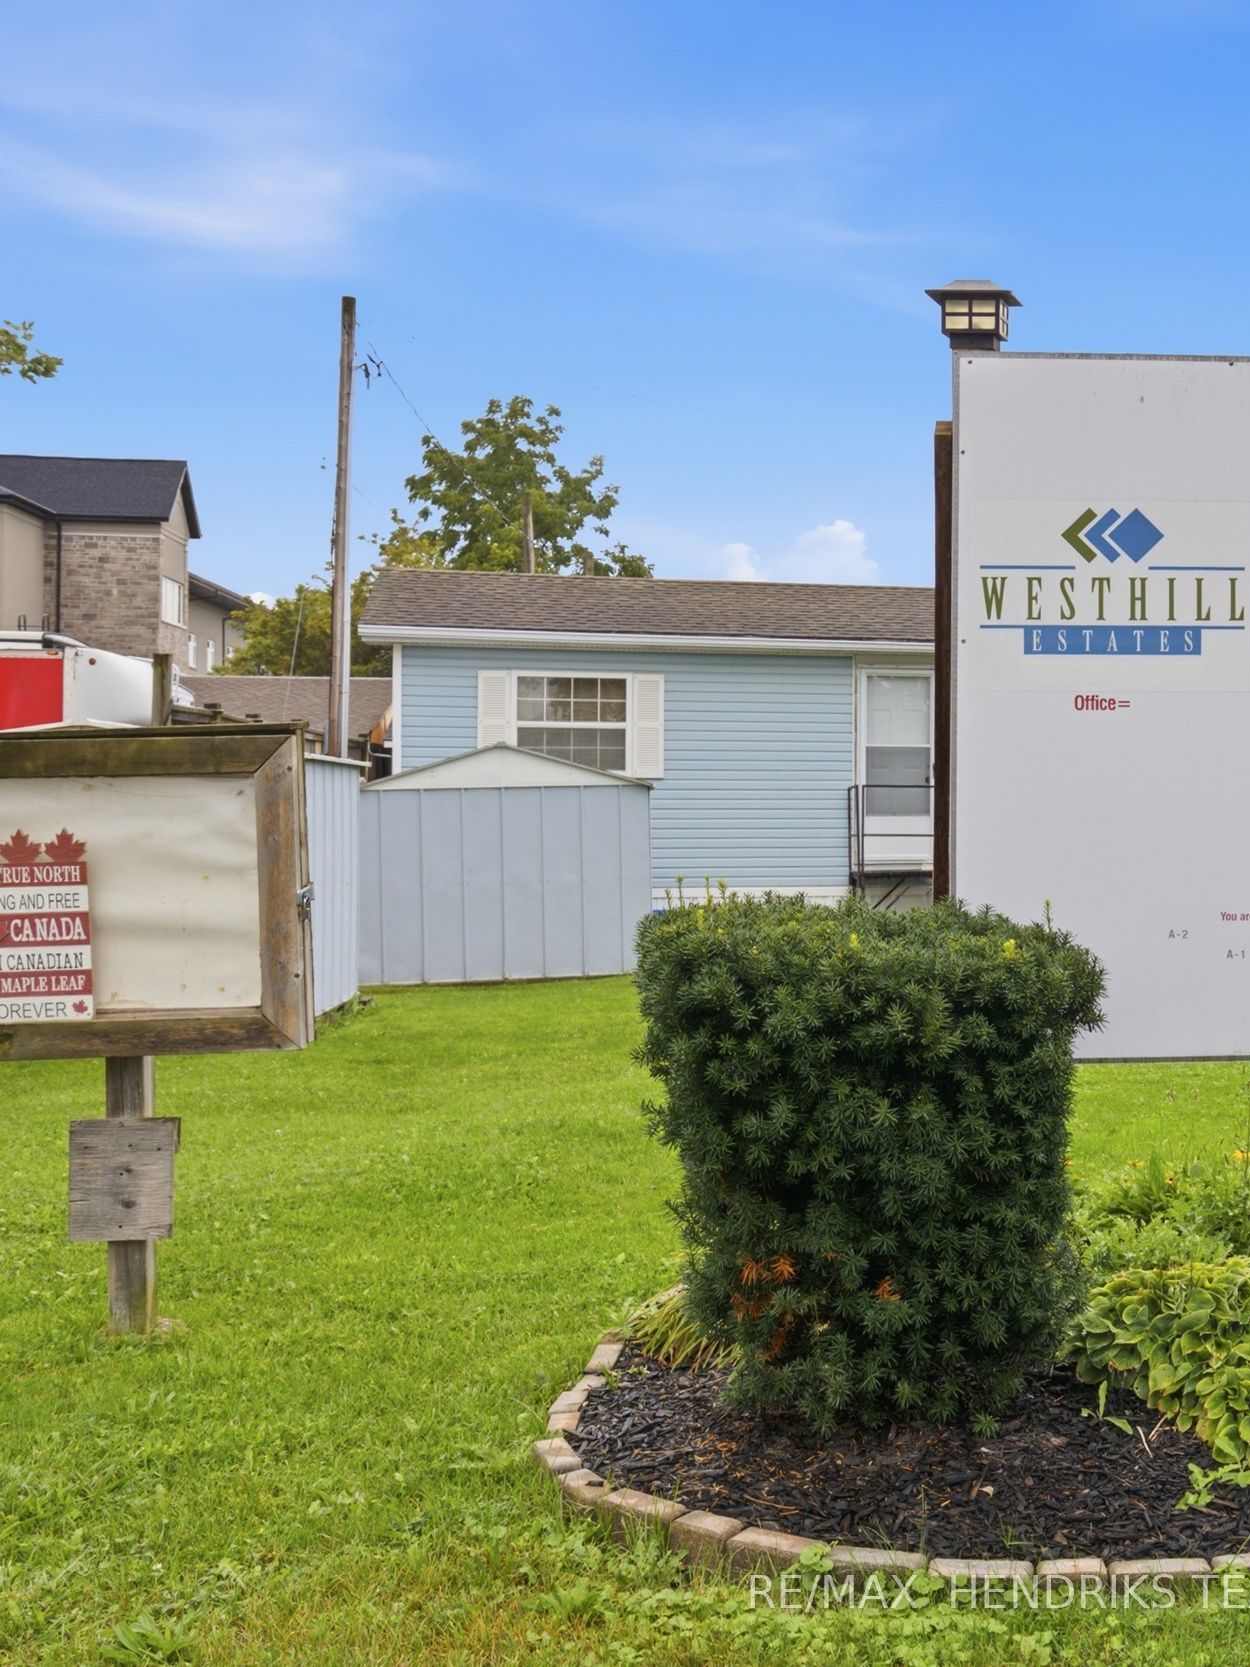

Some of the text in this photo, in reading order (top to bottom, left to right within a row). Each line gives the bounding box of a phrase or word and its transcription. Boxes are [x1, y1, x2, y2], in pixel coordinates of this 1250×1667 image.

[981, 576, 1246, 622] WESTHILL
[1031, 629, 1195, 653] ESTATES
[33, 865, 81, 883] NORTH
[19, 893, 45, 910] AND
[48, 892, 81, 909] FREE
[1220, 911, 1238, 922] You
[10, 916, 87, 942] CANADA
[1167, 928, 1189, 940] A-2
[6, 951, 84, 971] CANADIAN
[1226, 949, 1246, 961] A-1
[1, 974, 86, 993] MAPLE LEAF
